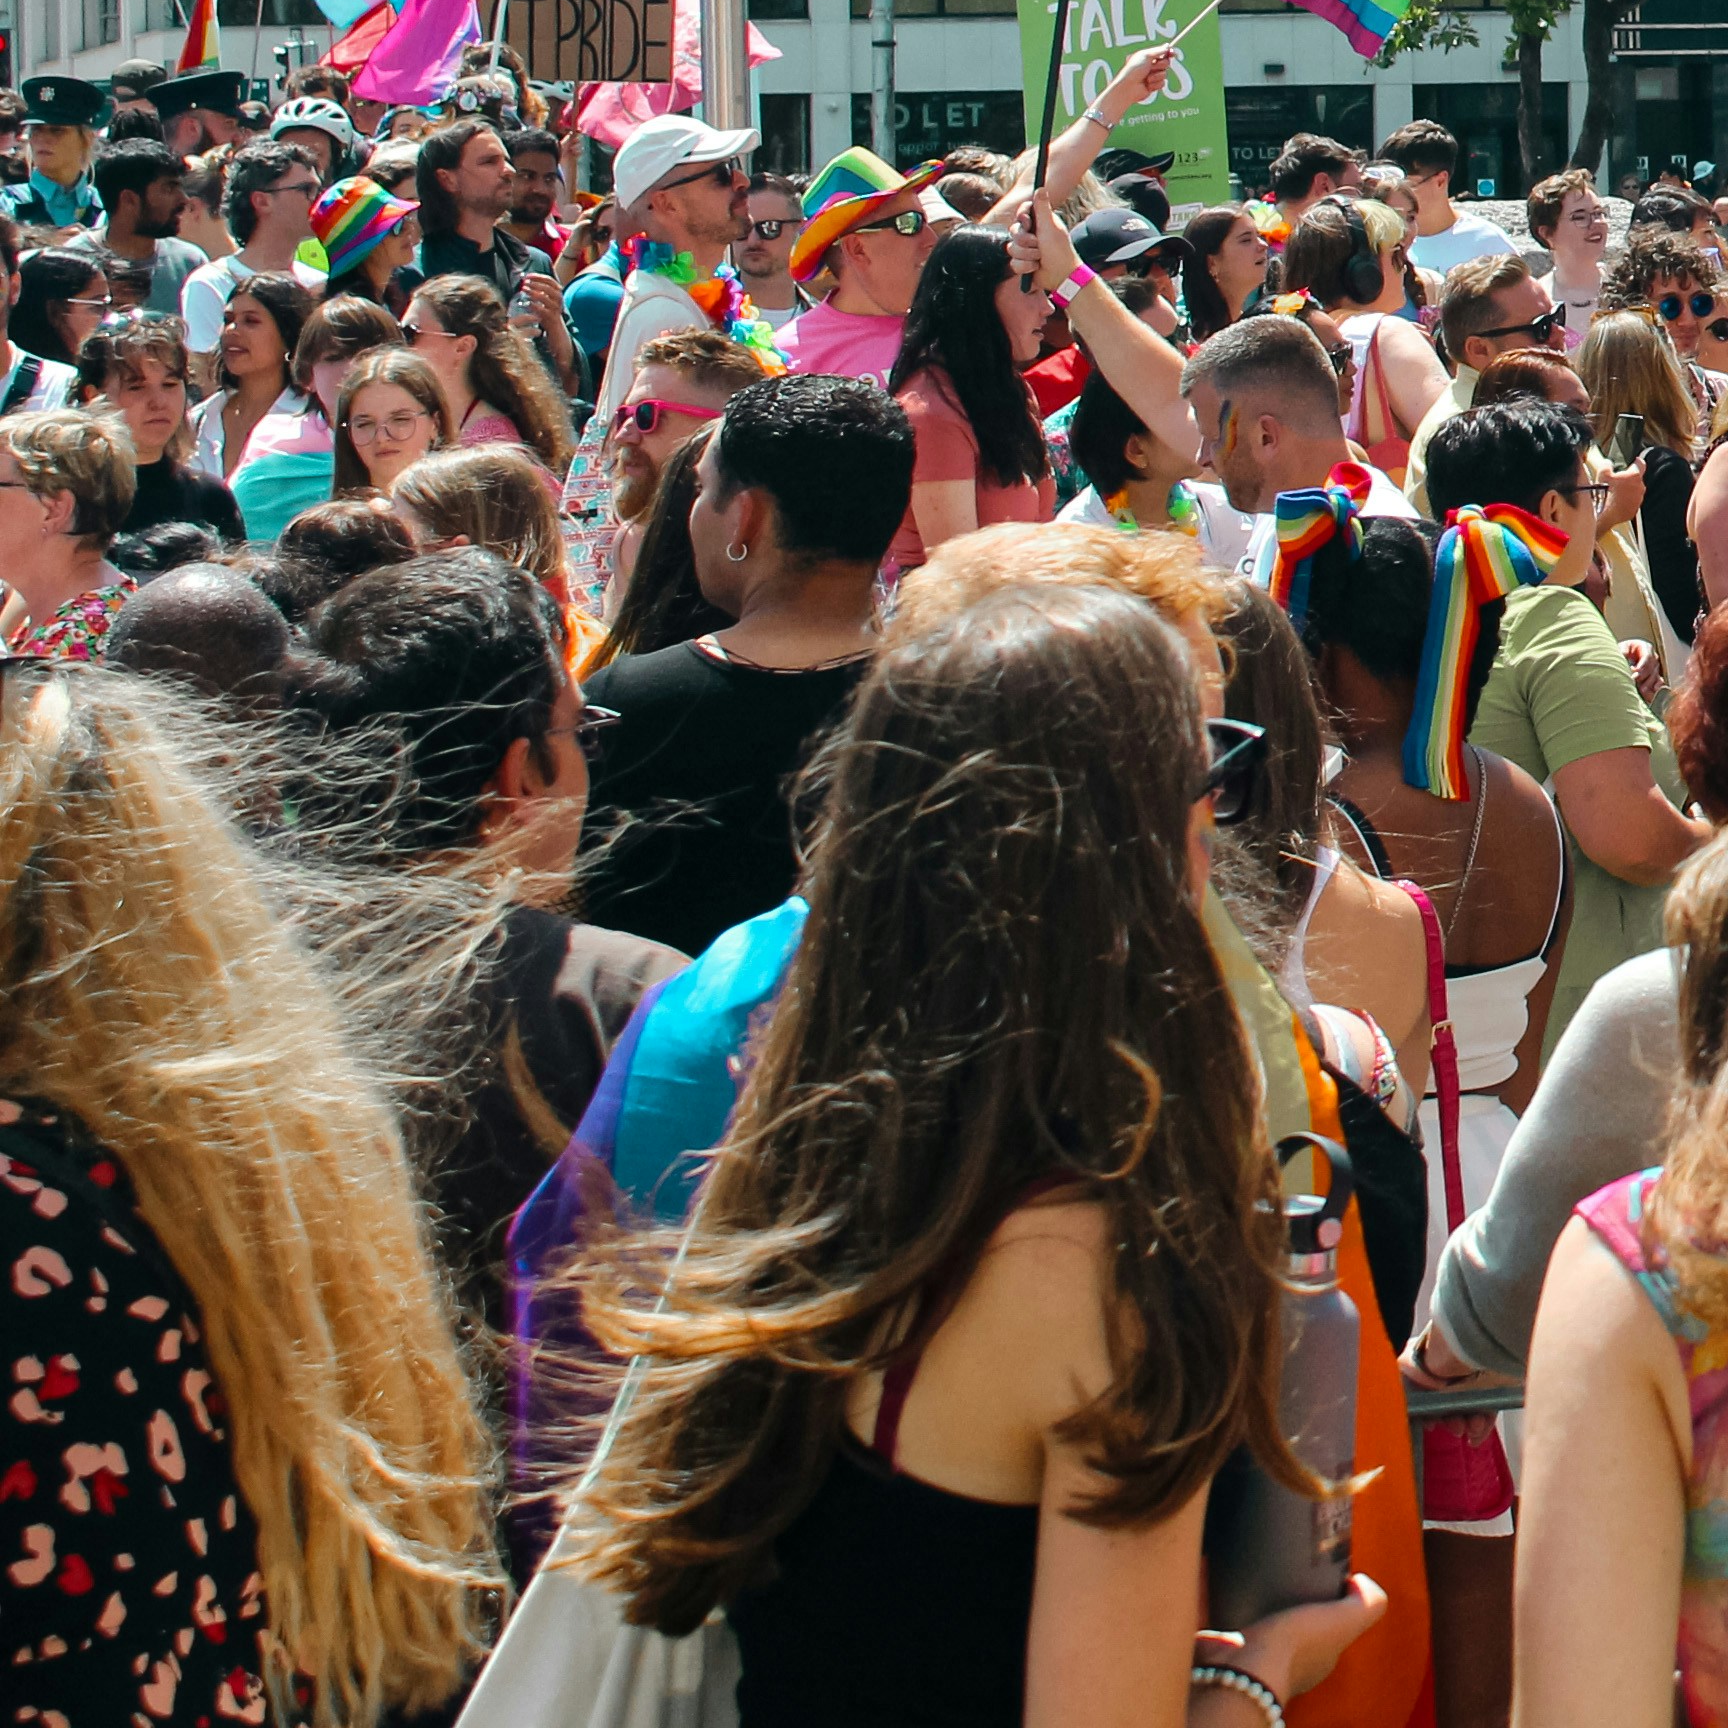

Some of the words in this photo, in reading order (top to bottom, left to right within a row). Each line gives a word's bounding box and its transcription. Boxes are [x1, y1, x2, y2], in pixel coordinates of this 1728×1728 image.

[1059, 59, 1115, 116] TO
[922, 102, 985, 129] LET
[1127, 112, 1165, 127] getting
[1167, 110, 1179, 119] to
[1181, 107, 1200, 118] you
[1178, 152, 1198, 163] 123
[1232, 147, 1254, 160] TO
